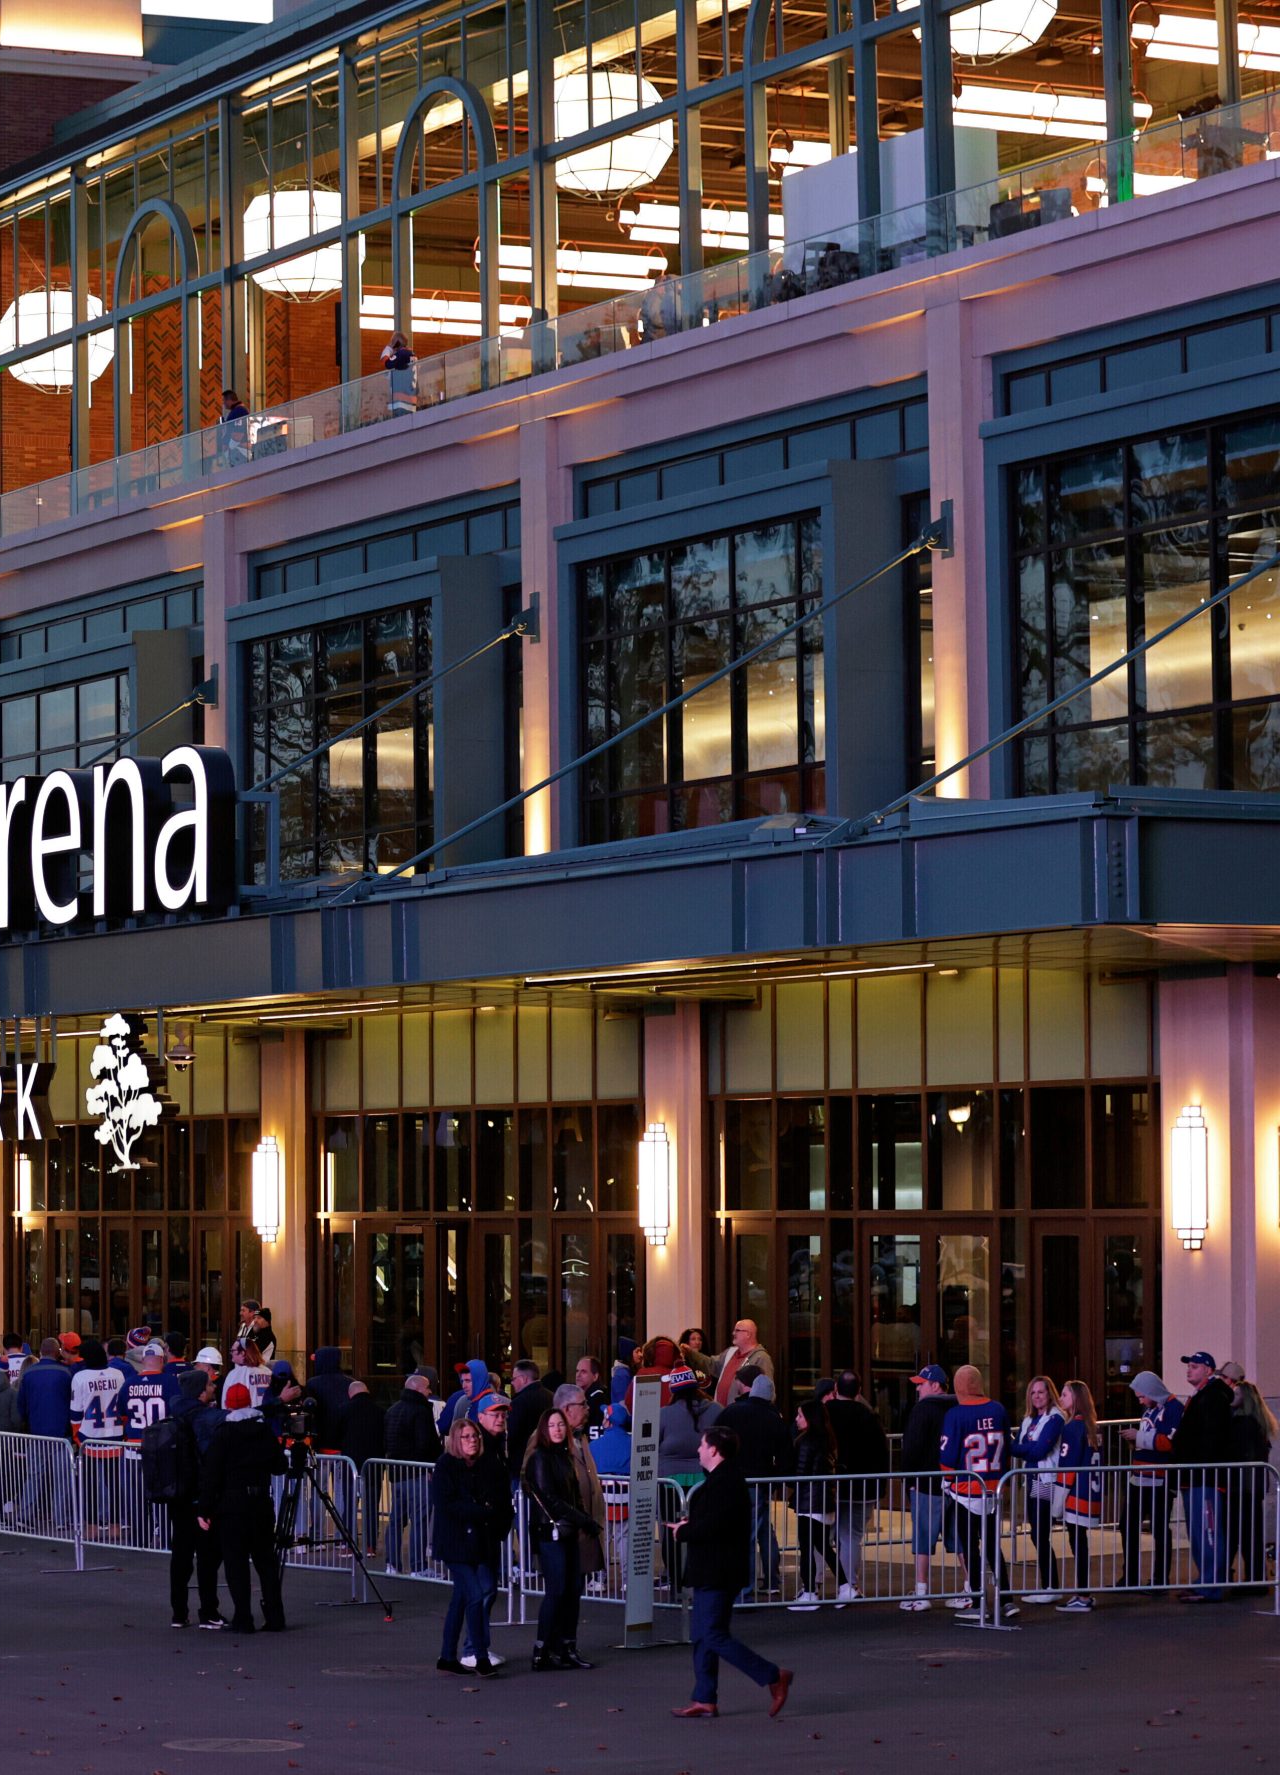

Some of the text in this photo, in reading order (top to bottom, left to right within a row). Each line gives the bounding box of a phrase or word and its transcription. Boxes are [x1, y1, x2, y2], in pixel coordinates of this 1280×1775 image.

[89, 1380, 117, 1392] PAGEAU
[128, 1385, 163, 1397] SOROKIN
[85, 1394, 120, 1428] 44
[127, 1398, 166, 1429] 30
[977, 1418, 995, 1431] LEE
[963, 1431, 1005, 1472] 27
[641, 1456, 651, 1467] BAG
[637, 1470, 654, 1481] POLICY
